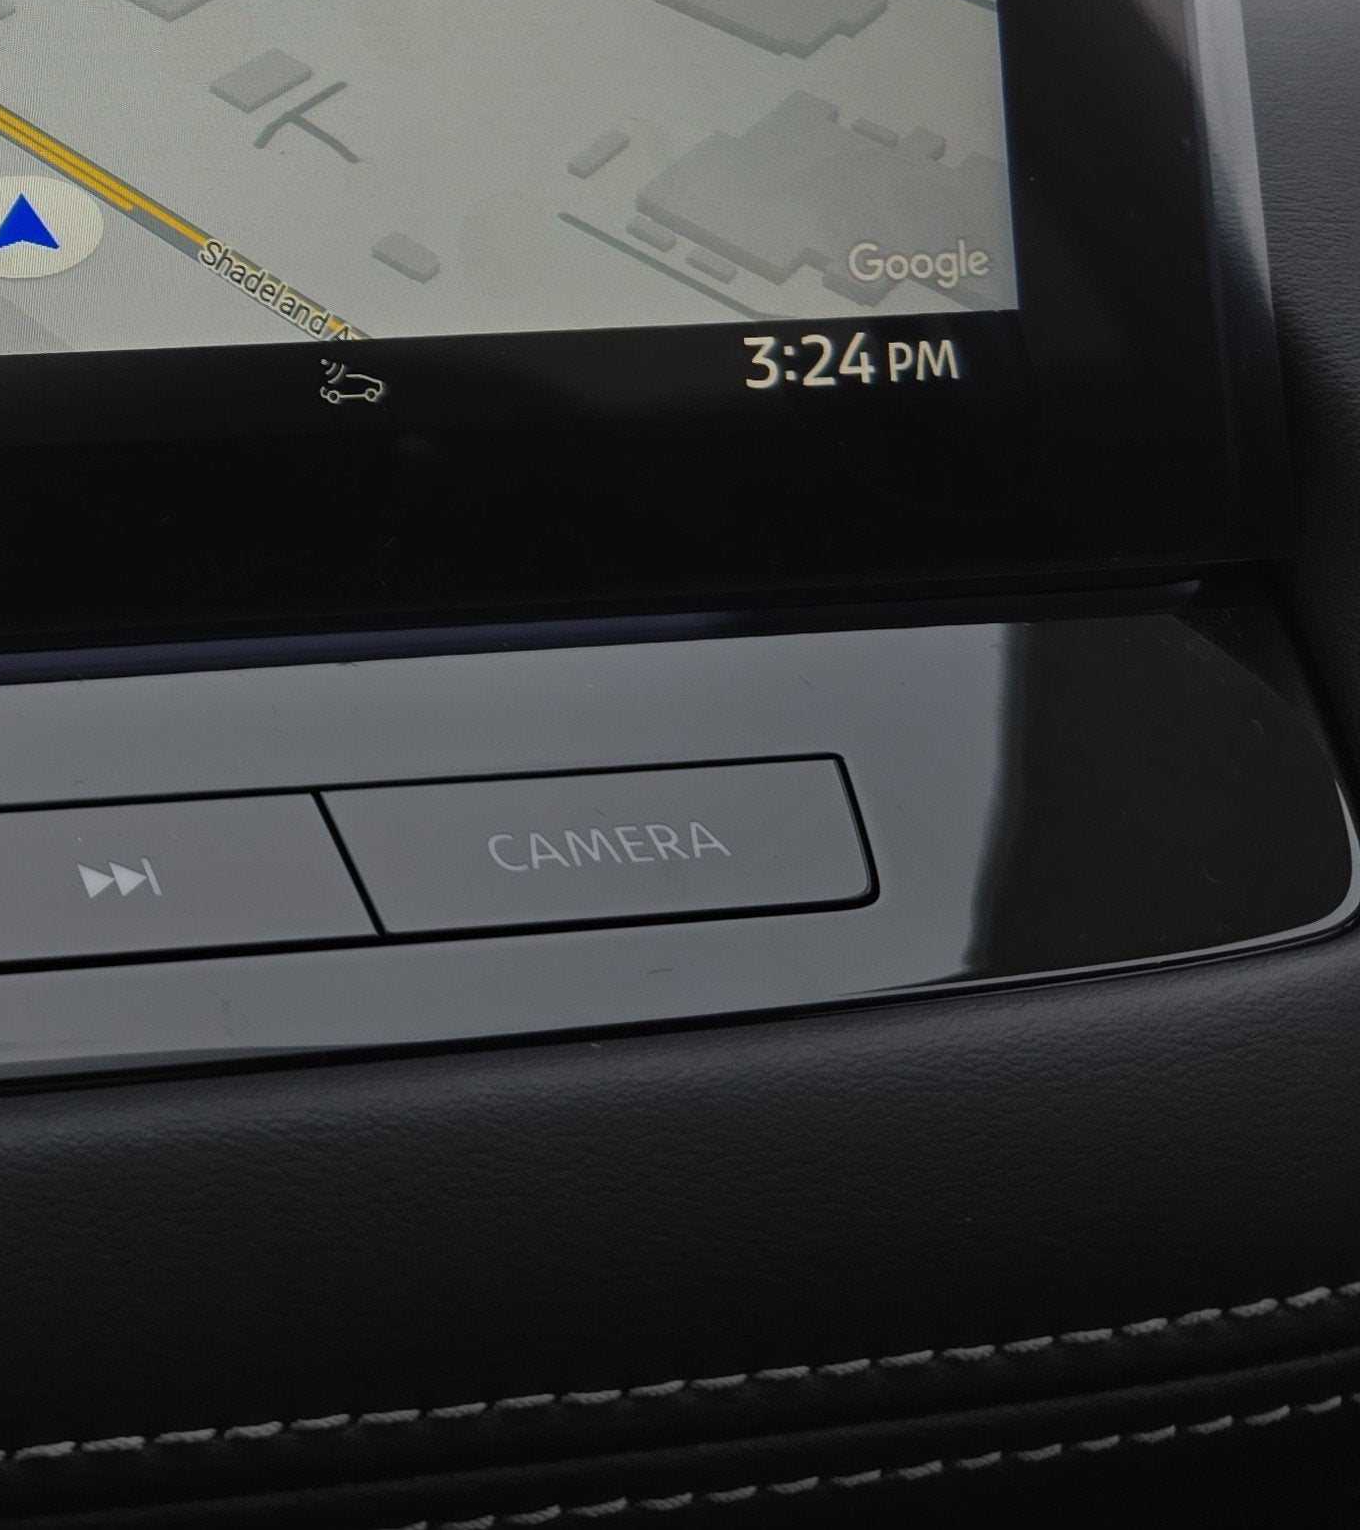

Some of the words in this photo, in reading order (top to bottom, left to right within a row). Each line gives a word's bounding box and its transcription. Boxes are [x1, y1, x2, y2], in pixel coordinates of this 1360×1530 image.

[200, 240, 330, 336] Shadeland
[849, 240, 989, 289] Google
[743, 332, 877, 390] 3:24
[888, 339, 960, 382] PM
[488, 821, 731, 871] CAMERA
